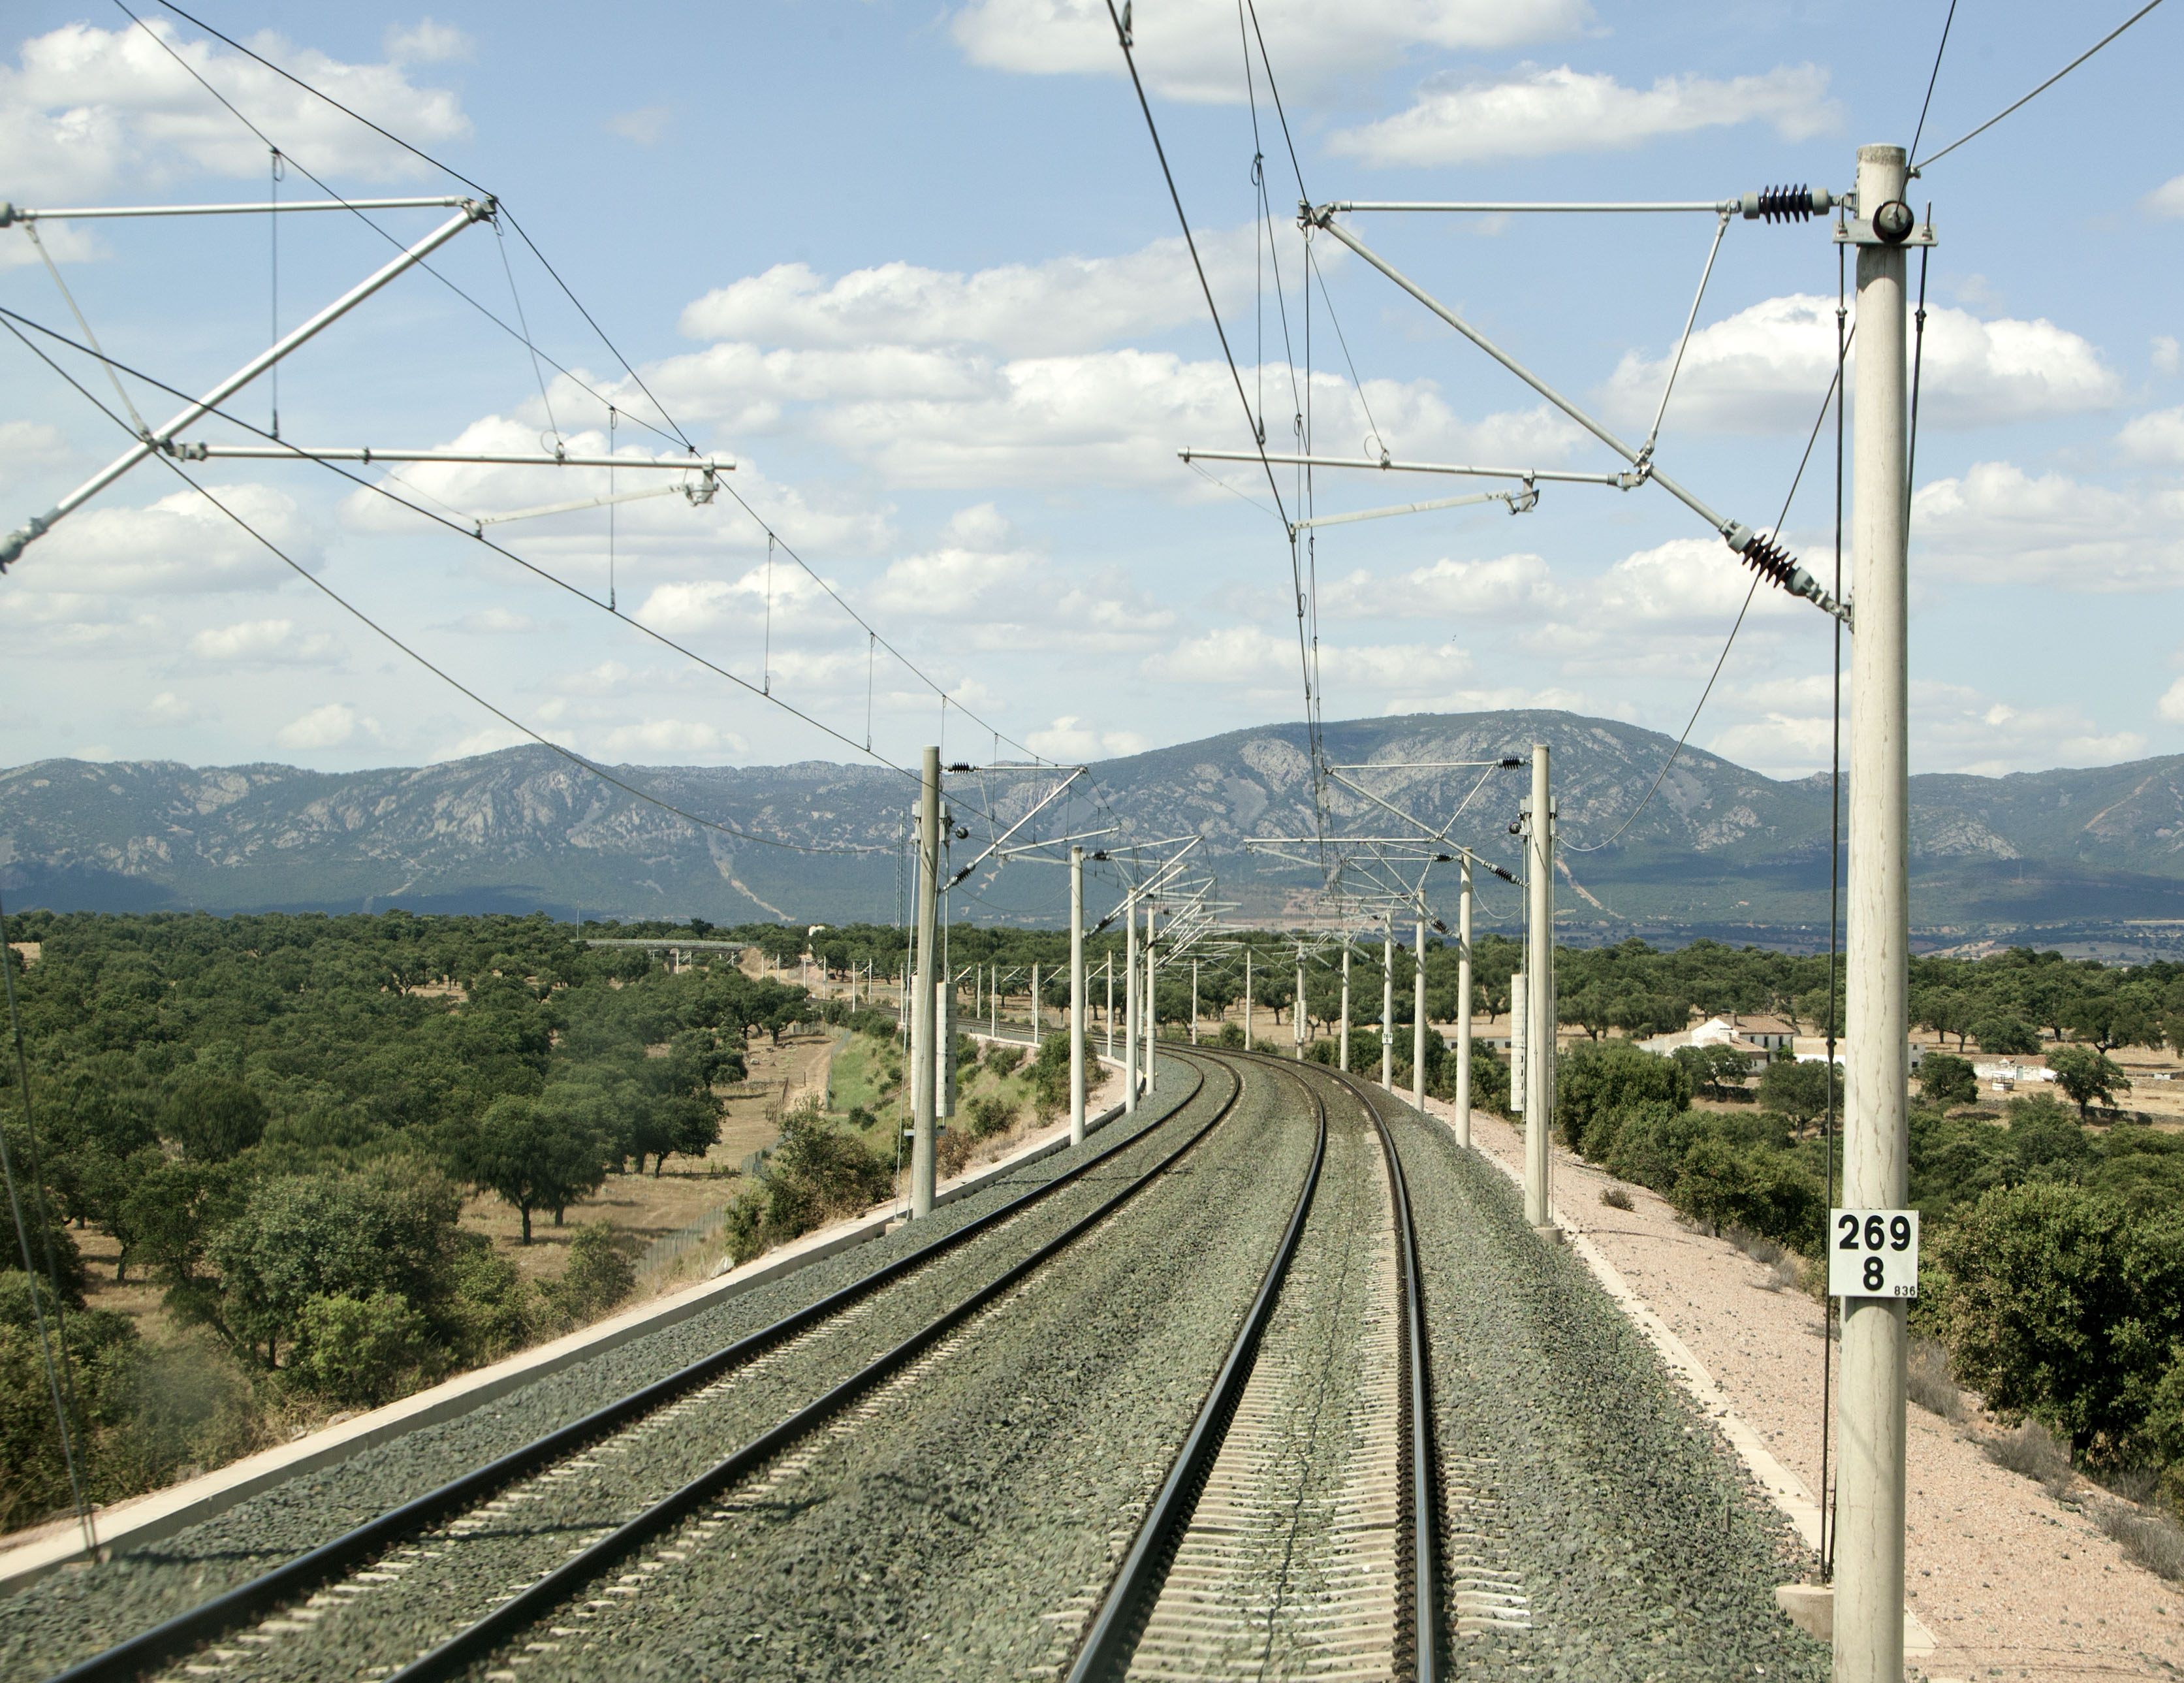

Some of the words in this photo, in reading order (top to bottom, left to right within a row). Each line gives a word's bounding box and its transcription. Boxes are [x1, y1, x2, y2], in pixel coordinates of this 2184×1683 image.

[1838, 1214, 1911, 1251] 269
[1863, 1256, 1884, 1291] 8
[1894, 1285, 1916, 1296] 836
